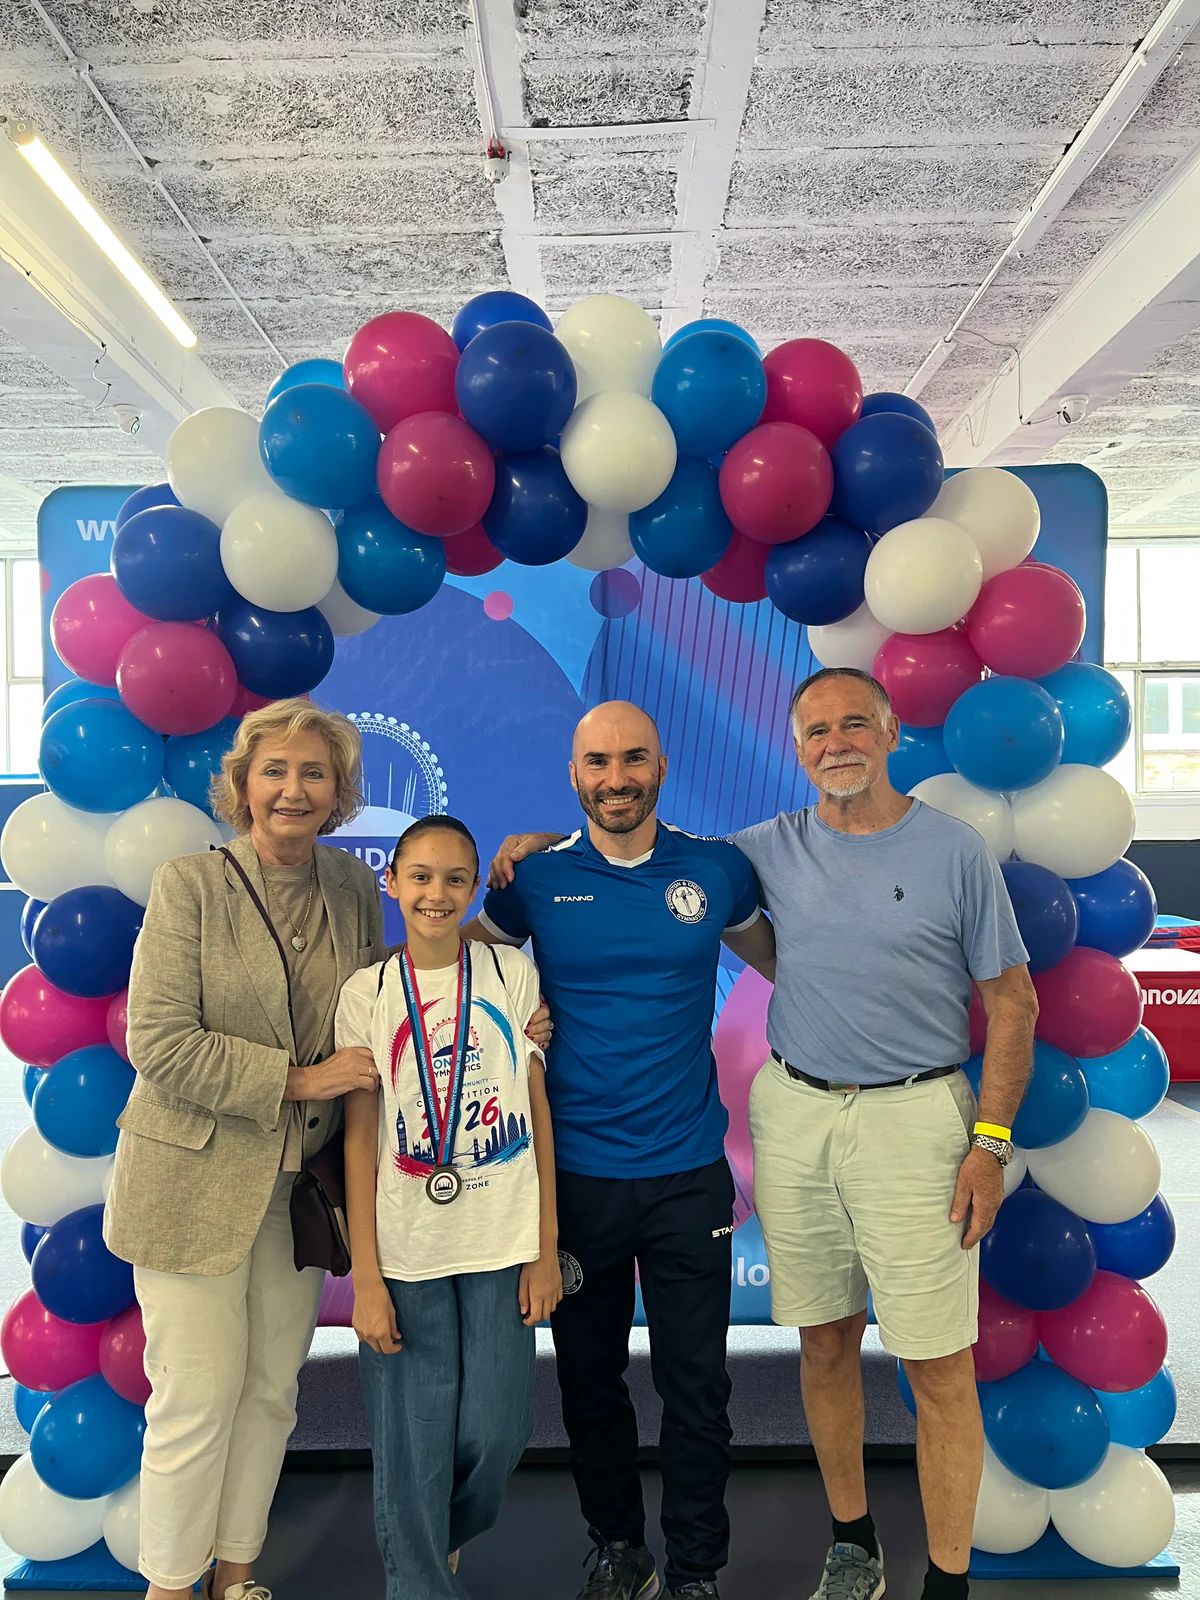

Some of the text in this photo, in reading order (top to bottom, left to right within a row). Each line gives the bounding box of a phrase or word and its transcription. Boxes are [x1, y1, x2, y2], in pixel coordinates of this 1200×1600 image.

[553, 895, 594, 903] STANNO
[688, 882, 705, 902] CHELSEA
[676, 907, 705, 921] GYMNASTICS
[433, 1051, 480, 1069] ONON
[451, 1061, 460, 1093] COMPETITION
[423, 1068, 432, 1097] COMMUNITY
[428, 1097, 438, 1128] COMPETITION
[447, 1093, 456, 1123] COMMUNITY
[465, 1180, 490, 1191] ZONE
